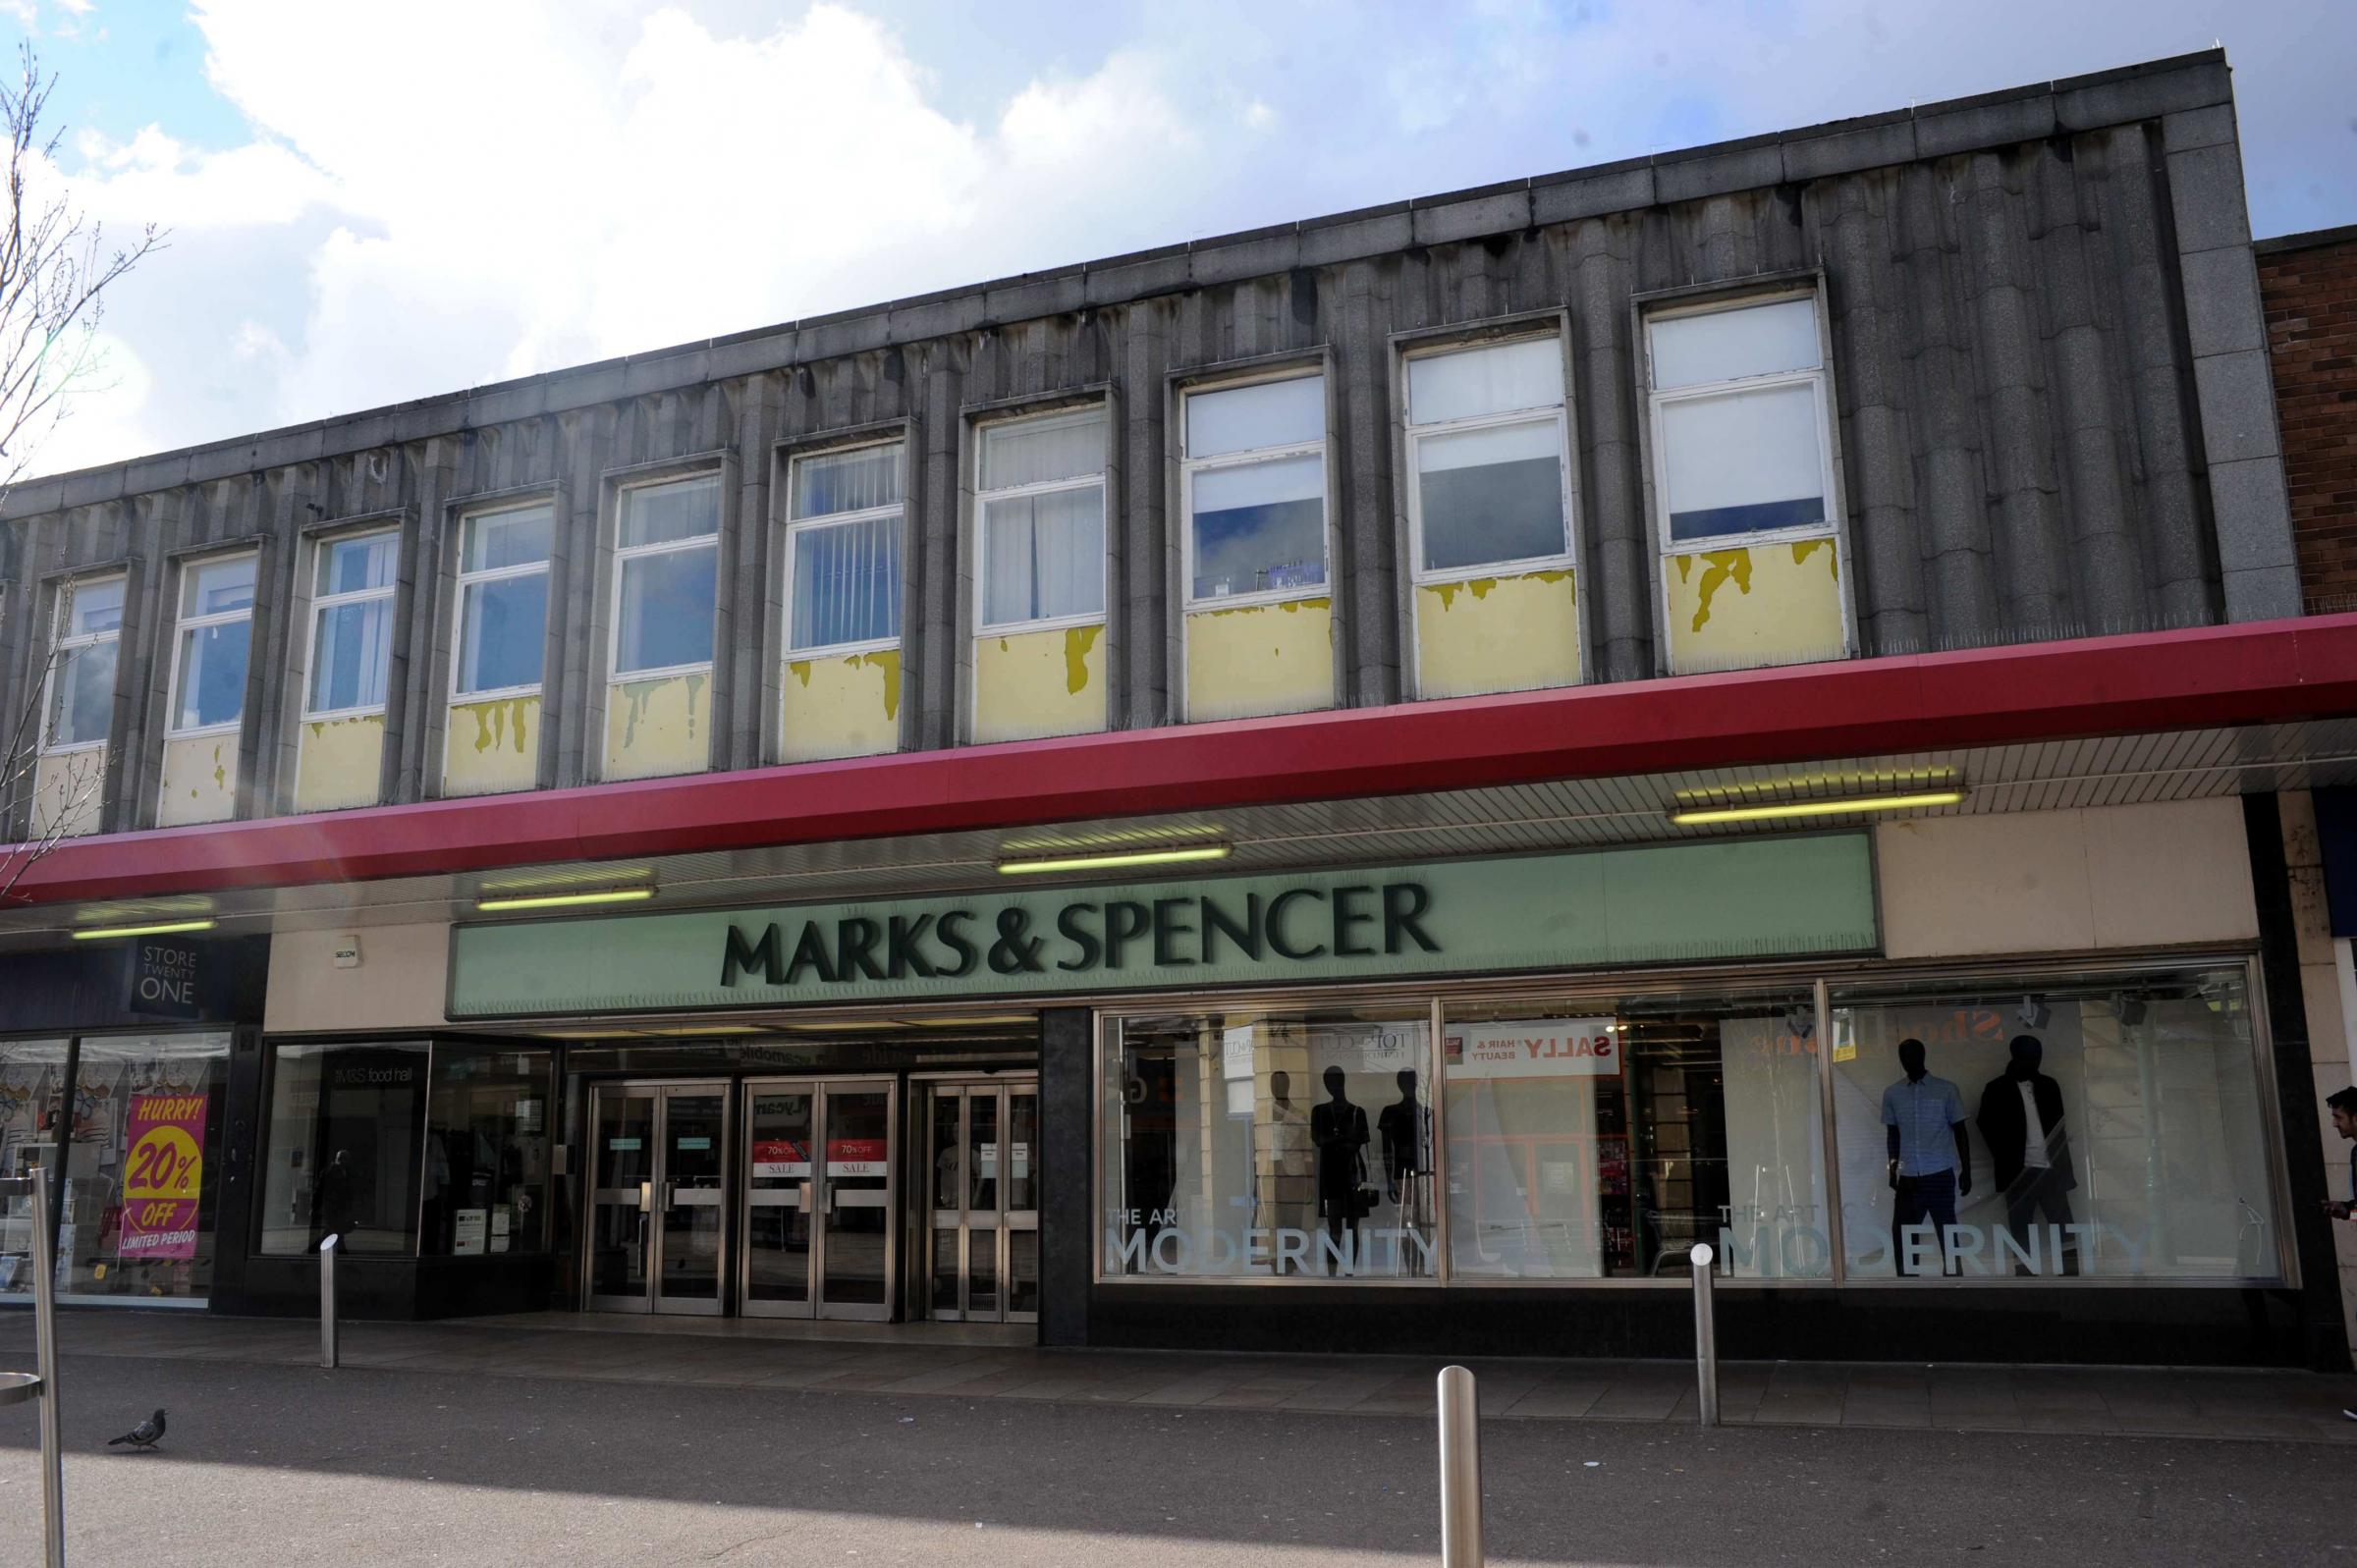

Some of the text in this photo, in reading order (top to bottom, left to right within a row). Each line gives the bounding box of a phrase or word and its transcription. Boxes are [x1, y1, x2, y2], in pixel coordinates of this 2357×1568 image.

[142, 945, 197, 969] STORE
[142, 962, 196, 980] TWENTY
[139, 976, 195, 1004] ONE
[368, 1066, 393, 1084] food
[394, 1066, 413, 1083] hall
[137, 1097, 204, 1122] HURRY!
[128, 1141, 198, 1191] 20%
[768, 1162, 795, 1174] SALE
[842, 1162, 870, 1173] SALE
[140, 1201, 178, 1227] OFF
[1717, 1205, 1763, 1223] THE
[121, 1228, 196, 1251] LIMITED PERIOD
[1105, 1227, 1439, 1275] MODERNITY
[1719, 1220, 2148, 1277] MODERNITY
